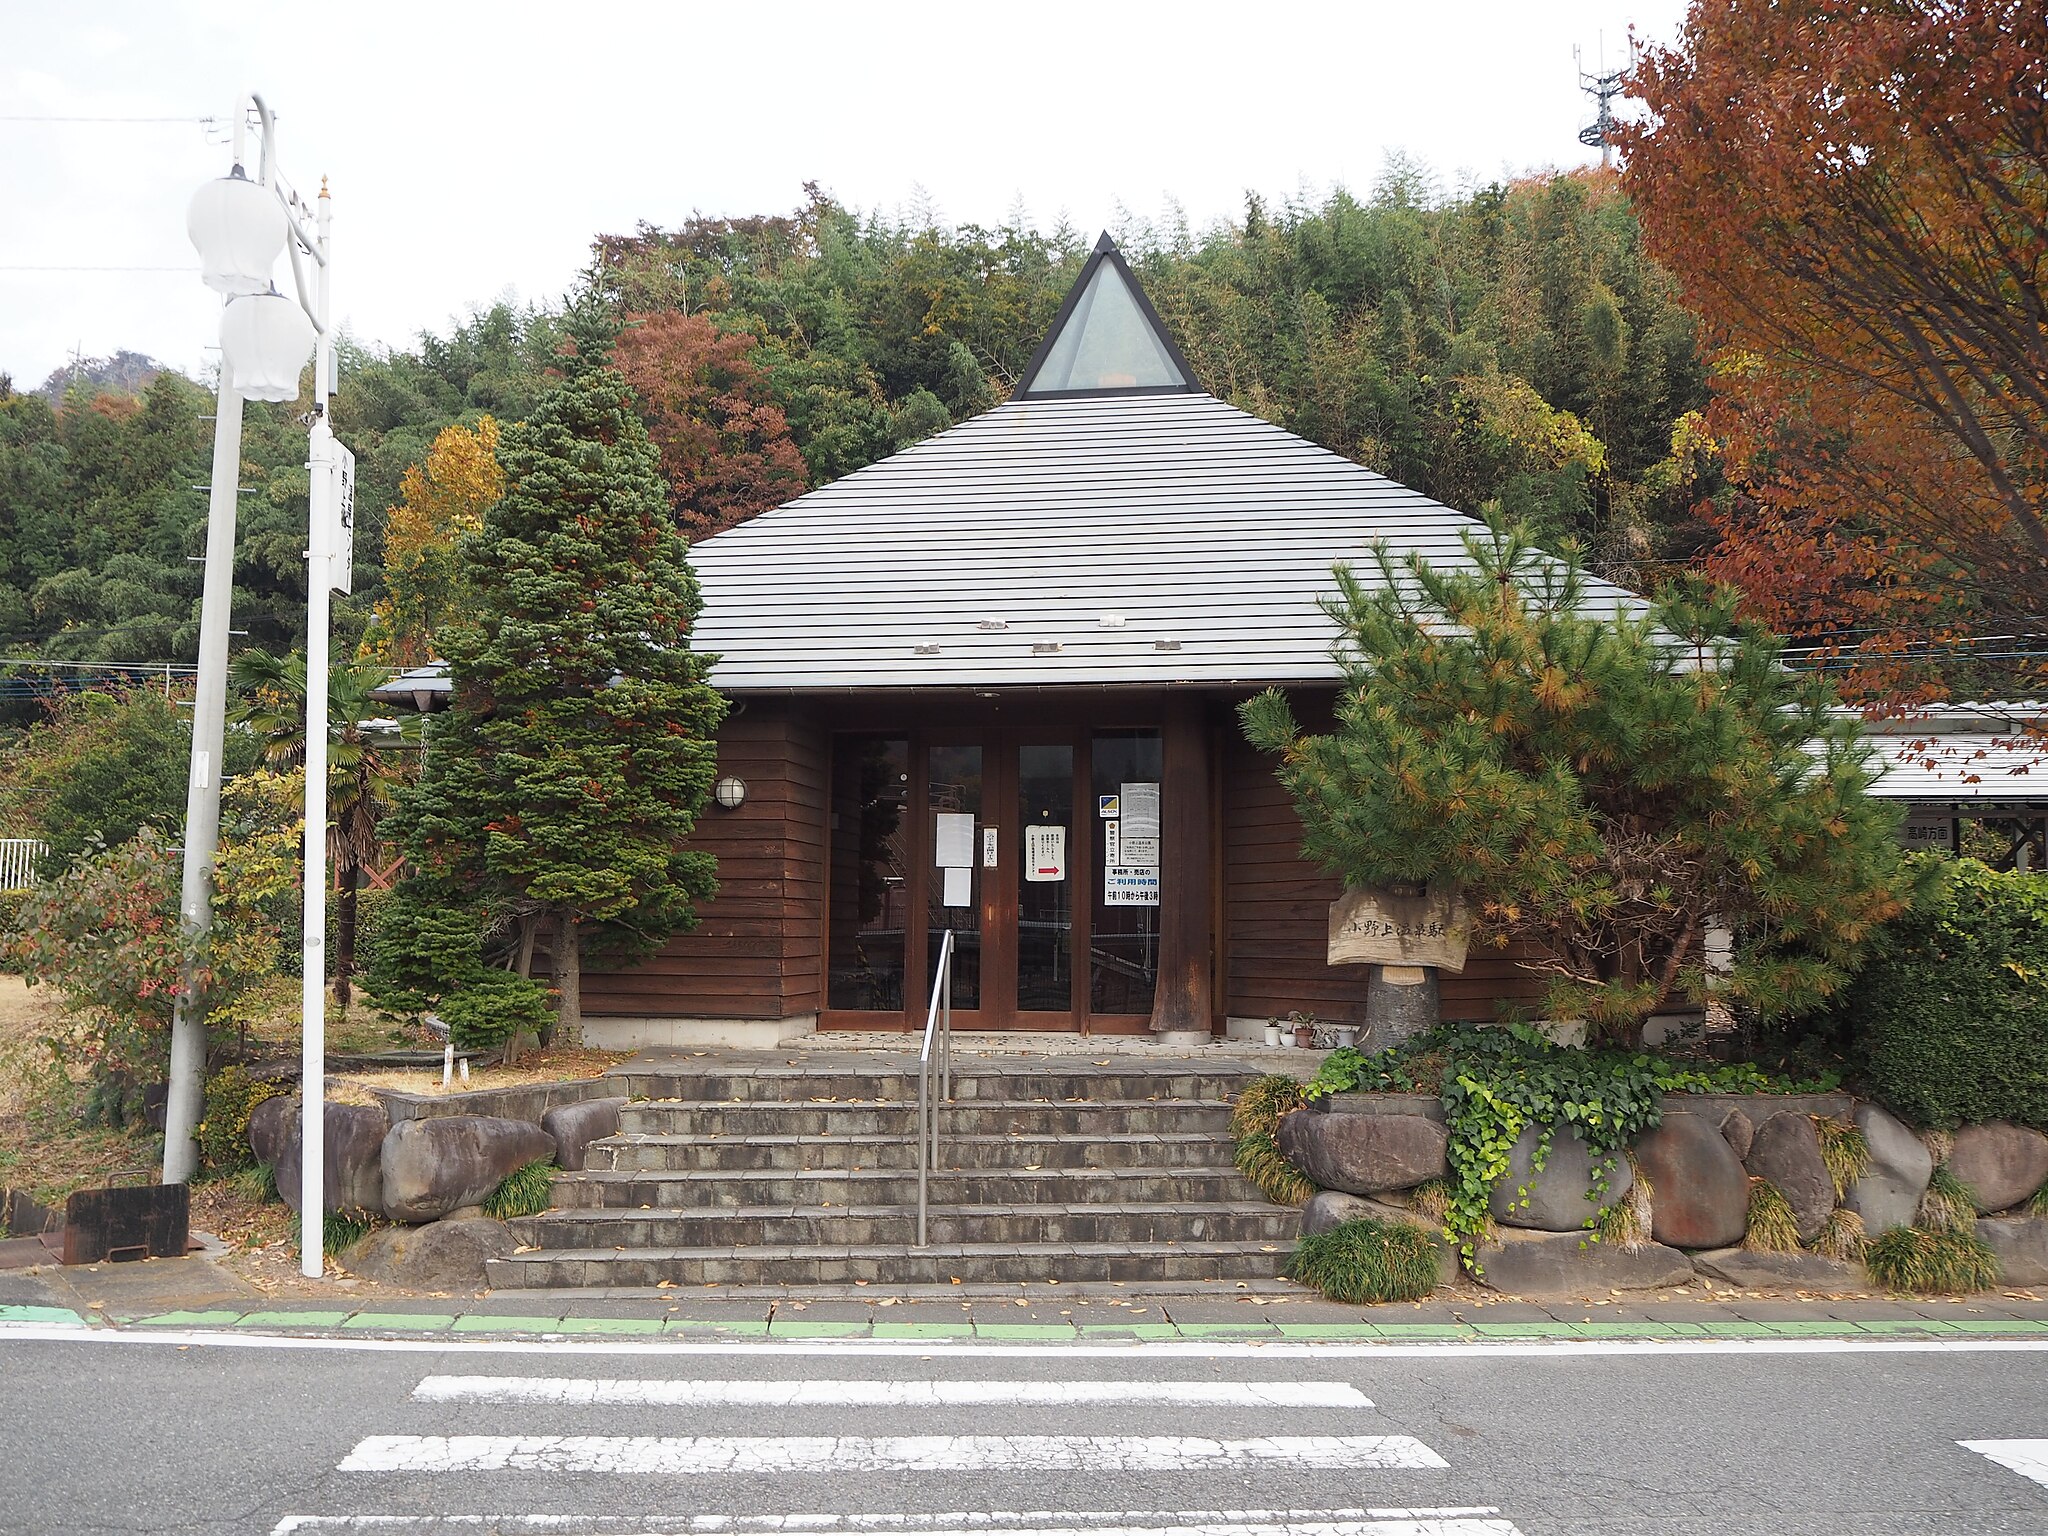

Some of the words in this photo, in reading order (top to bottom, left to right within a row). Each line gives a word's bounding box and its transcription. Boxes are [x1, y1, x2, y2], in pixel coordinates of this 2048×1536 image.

[1907, 826, 1947, 840] 高崎方面
[1107, 878, 1157, 886] ご利用時間
[1348, 920, 1446, 938] 小野上温泉駅
